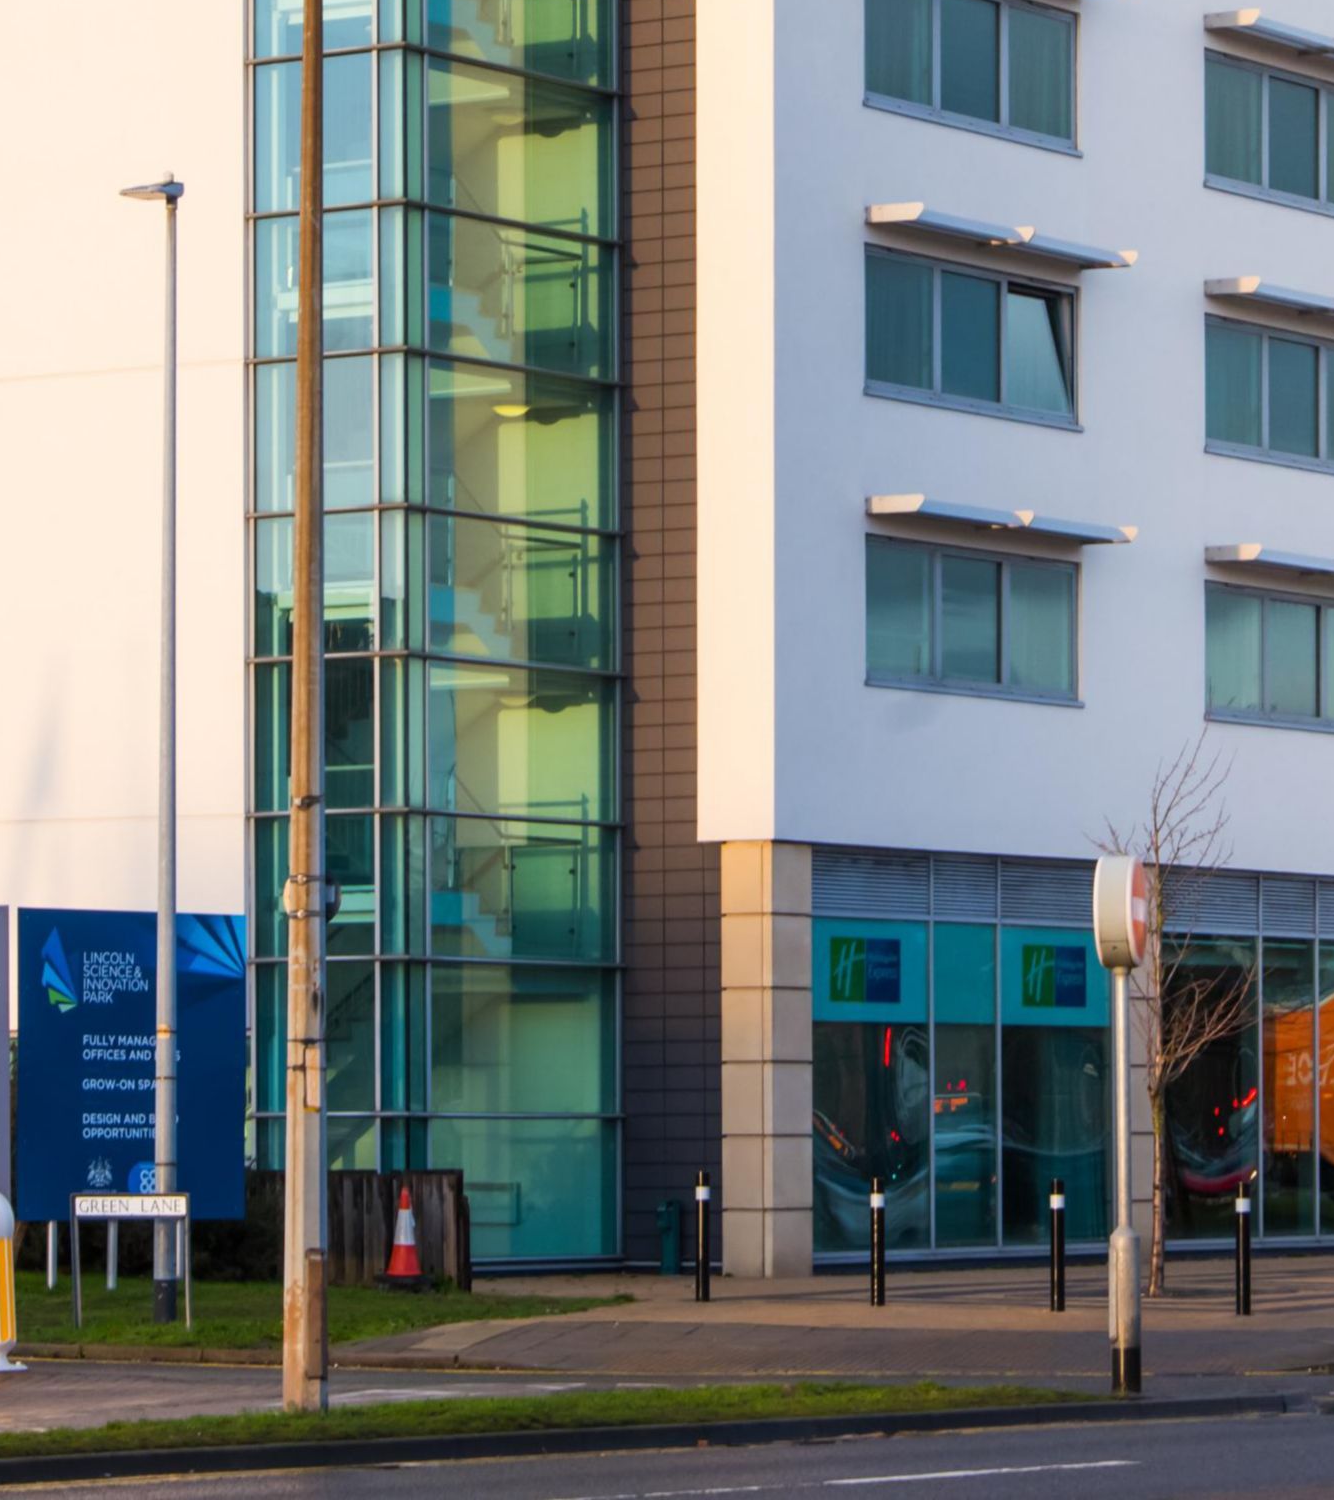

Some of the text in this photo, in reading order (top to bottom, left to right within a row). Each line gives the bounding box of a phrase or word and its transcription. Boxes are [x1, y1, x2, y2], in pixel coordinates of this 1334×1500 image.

[83, 952, 135, 965] LINCOLN
[82, 978, 149, 992] INNOVATION
[82, 991, 113, 1004] PARK
[82, 1034, 156, 1047] FULLY MANAG
[82, 1049, 126, 1061] OFFICES
[128, 1050, 152, 1061] AND
[82, 1078, 135, 1090] GROW-ON
[82, 1113, 121, 1125] DESIGN
[123, 1114, 146, 1125] AND
[78, 1199, 182, 1214] GREEN LANE
